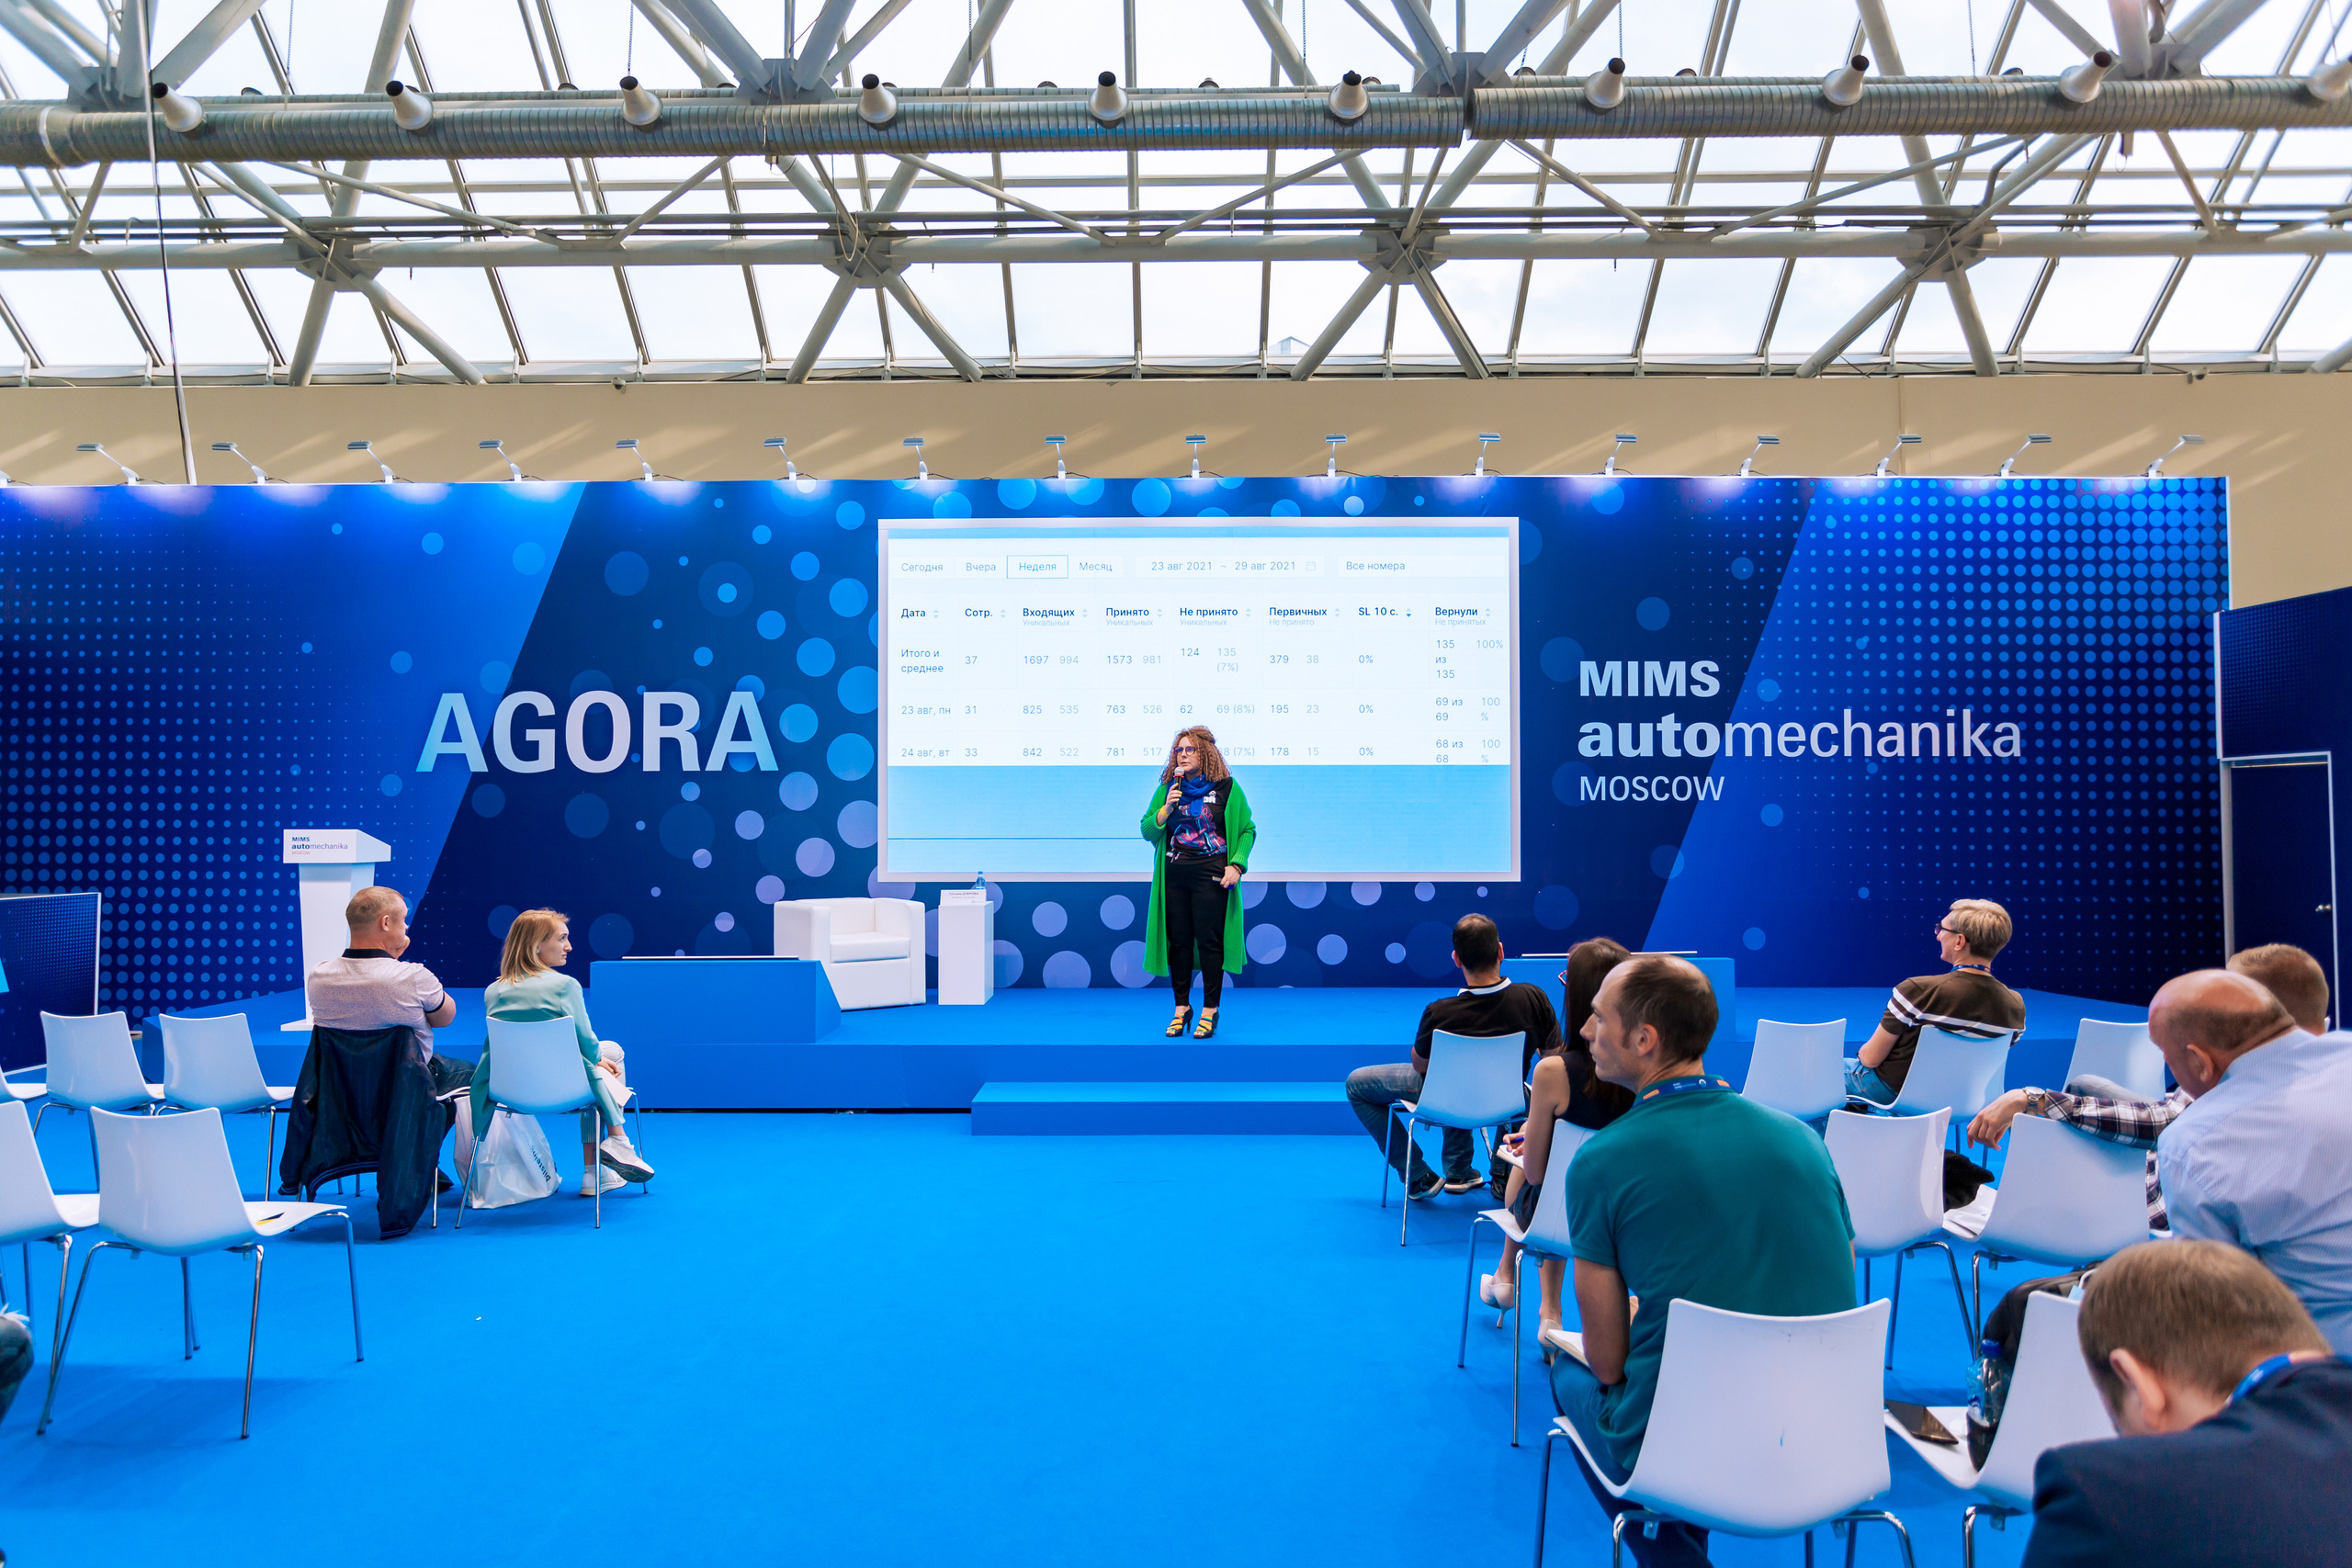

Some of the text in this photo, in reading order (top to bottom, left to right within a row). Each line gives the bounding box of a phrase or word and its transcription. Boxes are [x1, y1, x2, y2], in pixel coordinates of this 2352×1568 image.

[901, 562, 944, 573] Сегодня
[966, 562, 996, 571] Вчера
[1018, 561, 1057, 571] Неделя
[1079, 561, 1113, 572] Месяц
[1151, 561, 1165, 571] 23
[1167, 563, 1183, 571] авг
[1186, 561, 1212, 571] 2021
[1234, 561, 1248, 570] 29
[1250, 562, 1267, 570] авг
[1270, 561, 1295, 570] 2021
[1346, 561, 1406, 571] Все номера
[900, 608, 926, 619] Дата
[965, 608, 993, 618] Сотр.
[1023, 608, 1075, 617] Входящих
[1105, 608, 1150, 617] Принято
[1180, 608, 1238, 616] Не принято
[1269, 607, 1328, 616] Первичных
[1358, 607, 1371, 616] SL
[1374, 607, 1387, 616] 10
[1435, 607, 1478, 616] Вернули
[1436, 639, 1455, 649] 135
[1476, 639, 1504, 649] 100%
[900, 649, 931, 658] Итого
[1181, 648, 1200, 657] 124
[1216, 648, 1237, 657] 135
[965, 655, 978, 664] 37
[1023, 655, 1049, 664] 1697
[1059, 655, 1079, 664] 994
[1106, 655, 1133, 664] 1573
[1142, 655, 1161, 664] 981
[1270, 654, 1289, 663] 379
[1306, 654, 1319, 663] 38
[1358, 654, 1374, 663] 0%
[900, 665, 944, 674] среднее
[1216, 662, 1238, 673] (7%)
[1436, 670, 1455, 679] 135
[1579, 660, 1721, 698] MIMS
[1435, 697, 1463, 706] 69 из
[1481, 697, 1500, 706] 100
[901, 705, 951, 716] 23 авг, пн
[965, 705, 977, 715] 31
[1023, 705, 1042, 715] 825
[1059, 705, 1079, 715] 535
[1106, 705, 1125, 714] 763
[1143, 705, 1162, 714] 526
[1180, 705, 1193, 714] 62
[1216, 705, 1255, 715] 69 (8%)
[1270, 705, 1289, 714] 195
[1306, 705, 1319, 714] 23
[1358, 705, 1374, 714] 0%
[1435, 712, 1449, 721] 69
[1480, 712, 1489, 721] %
[415, 690, 780, 773] AGORA
[1577, 708, 2022, 757] automechanika
[1435, 739, 1463, 749] 68 из
[1481, 739, 1500, 749] 100
[901, 748, 914, 757] 24
[917, 750, 935, 759] авг,
[964, 748, 978, 757] 33
[1023, 748, 1042, 757] 842
[1059, 748, 1079, 757] 522
[1106, 748, 1125, 756] 781
[1143, 747, 1162, 757] 517
[1233, 747, 1255, 758] (7%)
[1270, 747, 1289, 756] 178
[1306, 747, 1319, 756] 15
[1359, 747, 1374, 756] 0%
[1435, 754, 1449, 763] 68
[1481, 754, 1489, 763] %
[1579, 775, 1725, 802] MOSCOW
